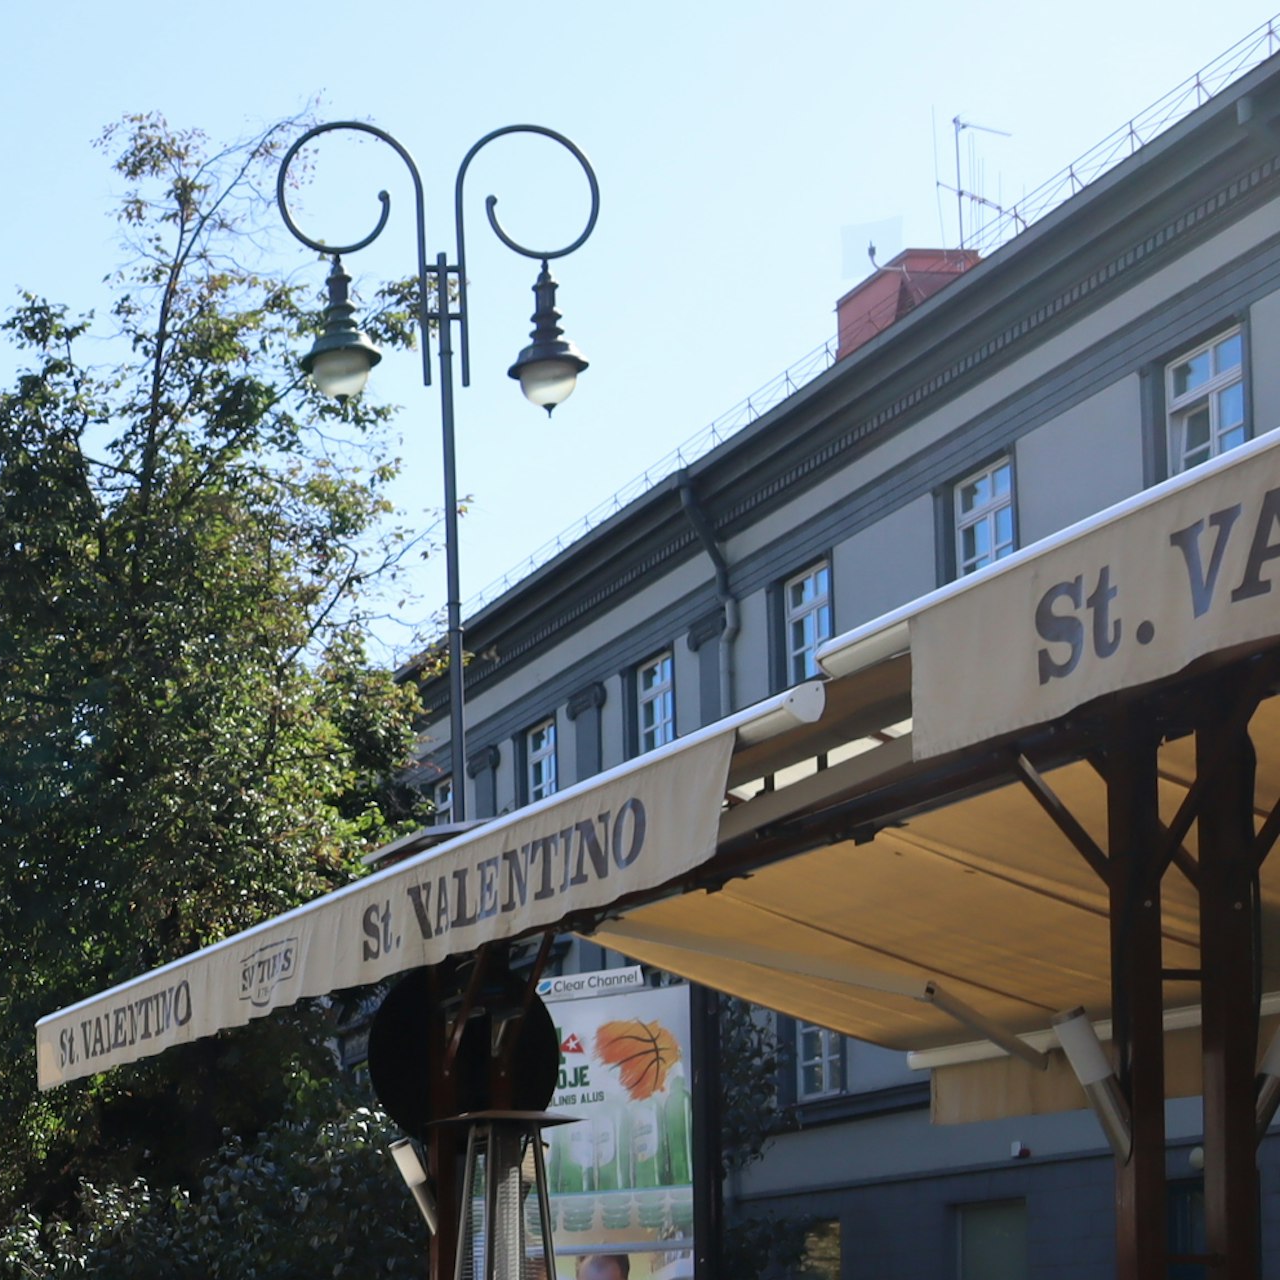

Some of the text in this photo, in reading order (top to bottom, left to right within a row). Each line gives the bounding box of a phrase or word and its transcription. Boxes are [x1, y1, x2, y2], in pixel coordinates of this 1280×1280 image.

[1034, 564, 1156, 687] St.
[362, 797, 647, 963] St. VALENTINO
[59, 979, 193, 1068] St. VALENTINO
[553, 971, 638, 993] Clear Channel
[580, 1091, 605, 1104] ALUS
